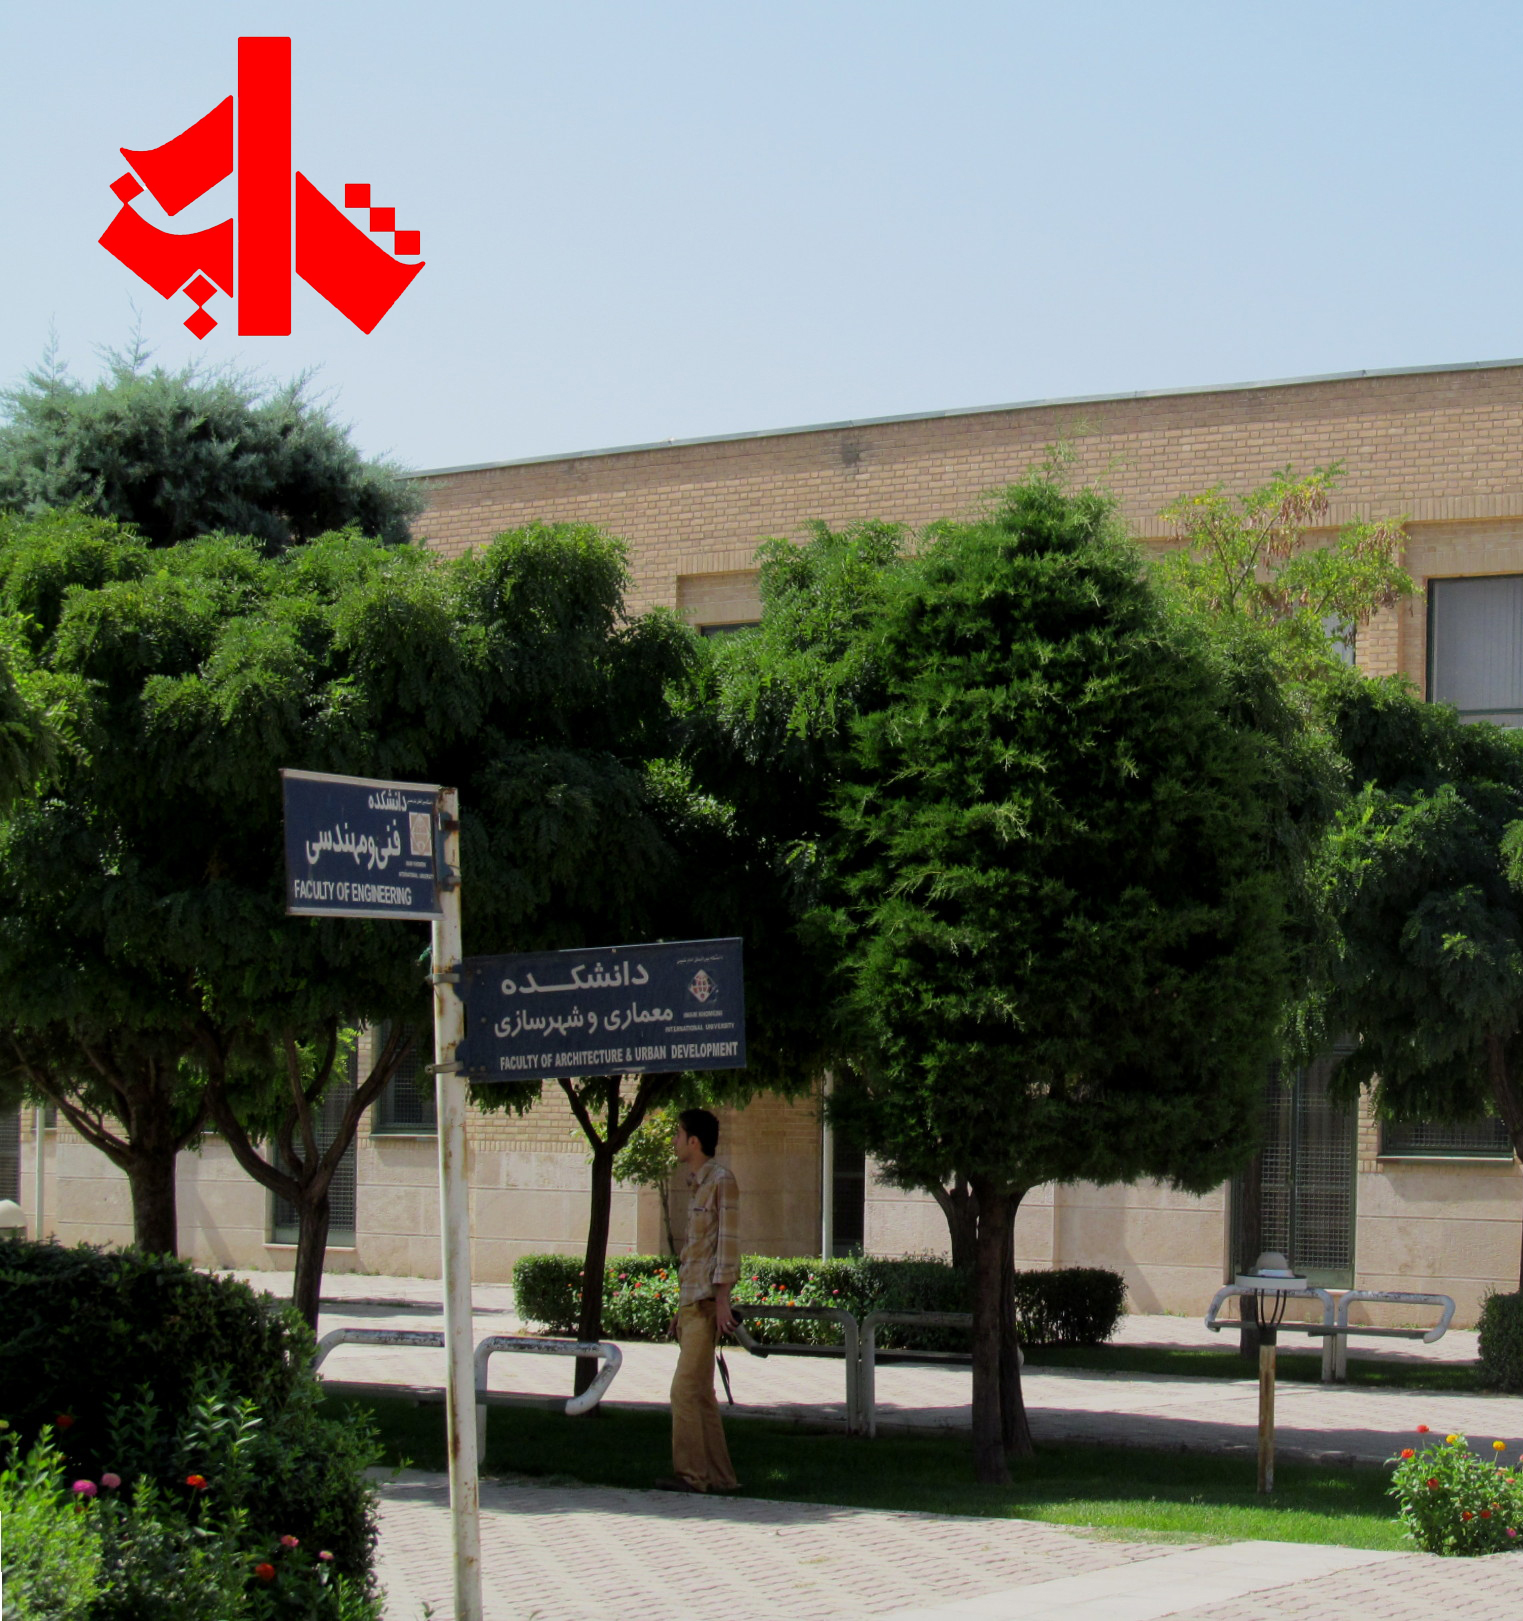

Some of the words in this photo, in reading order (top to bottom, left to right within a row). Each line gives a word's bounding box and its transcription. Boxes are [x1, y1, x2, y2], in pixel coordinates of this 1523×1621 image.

[368, 789, 408, 812] دانشکده
[306, 822, 367, 866] مهندسی
[375, 819, 401, 870] فنی
[294, 880, 335, 901] FACULTY
[336, 882, 350, 901] OF
[352, 883, 412, 906] ENGINEERING
[501, 960, 650, 995] دانشکده
[494, 1006, 584, 1039] شهرسازی
[588, 1014, 598, 1035] و
[604, 1002, 674, 1031] معماری
[500, 1054, 539, 1071] FACULTY
[541, 1052, 554, 1068] OF
[555, 1047, 623, 1067] ARCHITECTURE
[625, 1047, 634, 1062] &
[635, 1045, 667, 1062] URBAN
[671, 1041, 739, 1060] DEVELOPMENT
